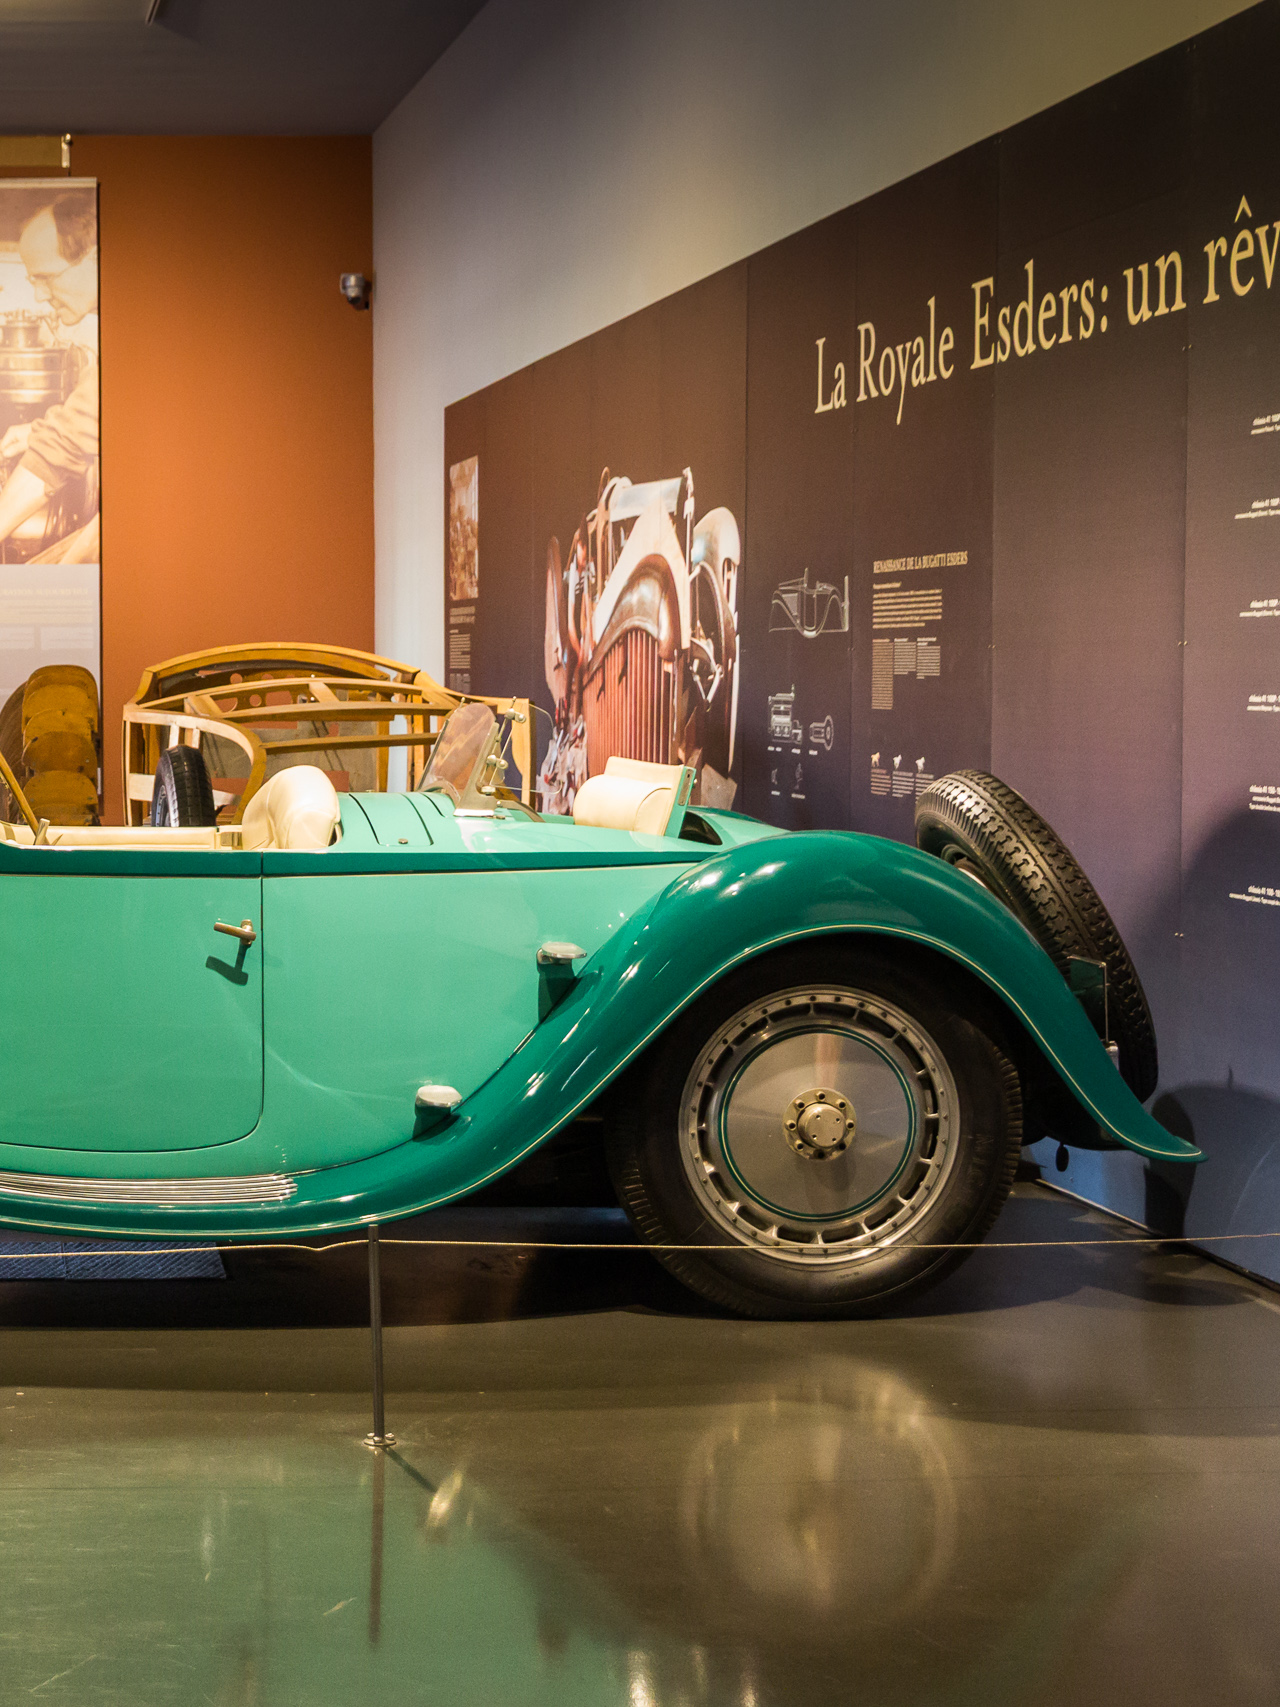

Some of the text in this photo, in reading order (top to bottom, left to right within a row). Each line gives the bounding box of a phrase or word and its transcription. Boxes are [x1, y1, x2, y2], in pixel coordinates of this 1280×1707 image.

[814, 337, 848, 415] La
[856, 295, 955, 426] Royale
[970, 258, 1110, 371] Esders:
[1122, 250, 1187, 326] un
